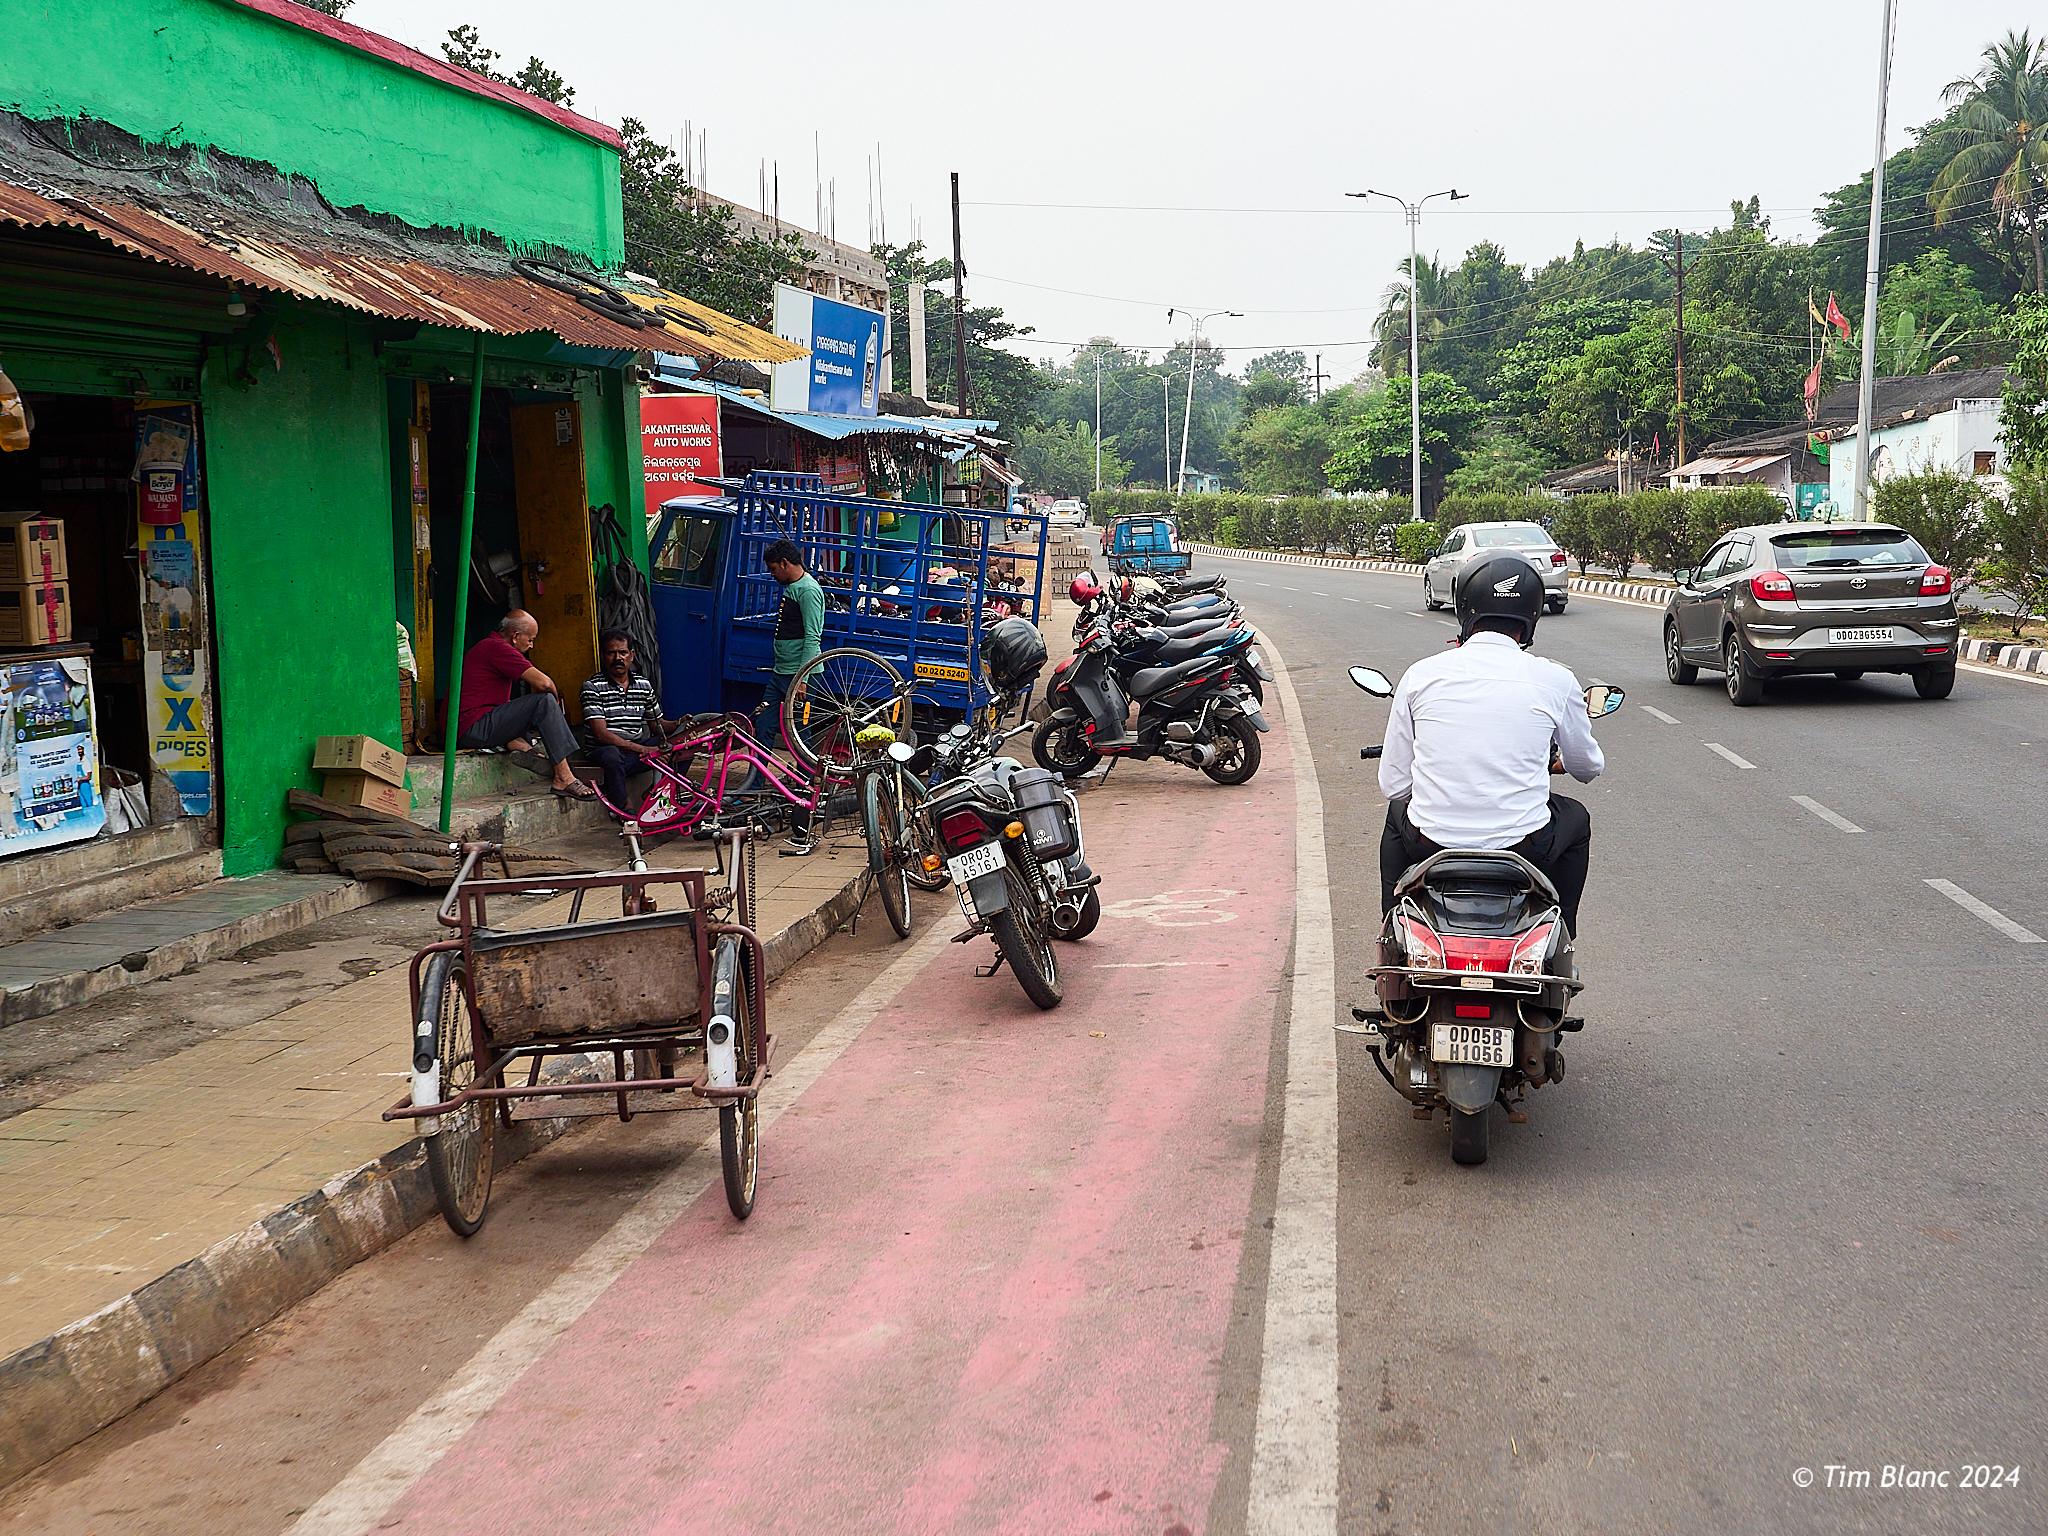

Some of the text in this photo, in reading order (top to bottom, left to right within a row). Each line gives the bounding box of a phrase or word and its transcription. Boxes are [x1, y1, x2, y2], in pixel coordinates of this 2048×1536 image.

[653, 437, 712, 447] AUTO WORKS
[1836, 629, 1893, 640] OD02BG5554
[946, 671, 966, 679] 5240
[1033, 835, 1053, 845] KIWI
[960, 846, 991, 866] OR03
[963, 856, 999, 880] A5161
[1449, 1026, 1503, 1046] OD05B
[1449, 1043, 1503, 1063] H1056
